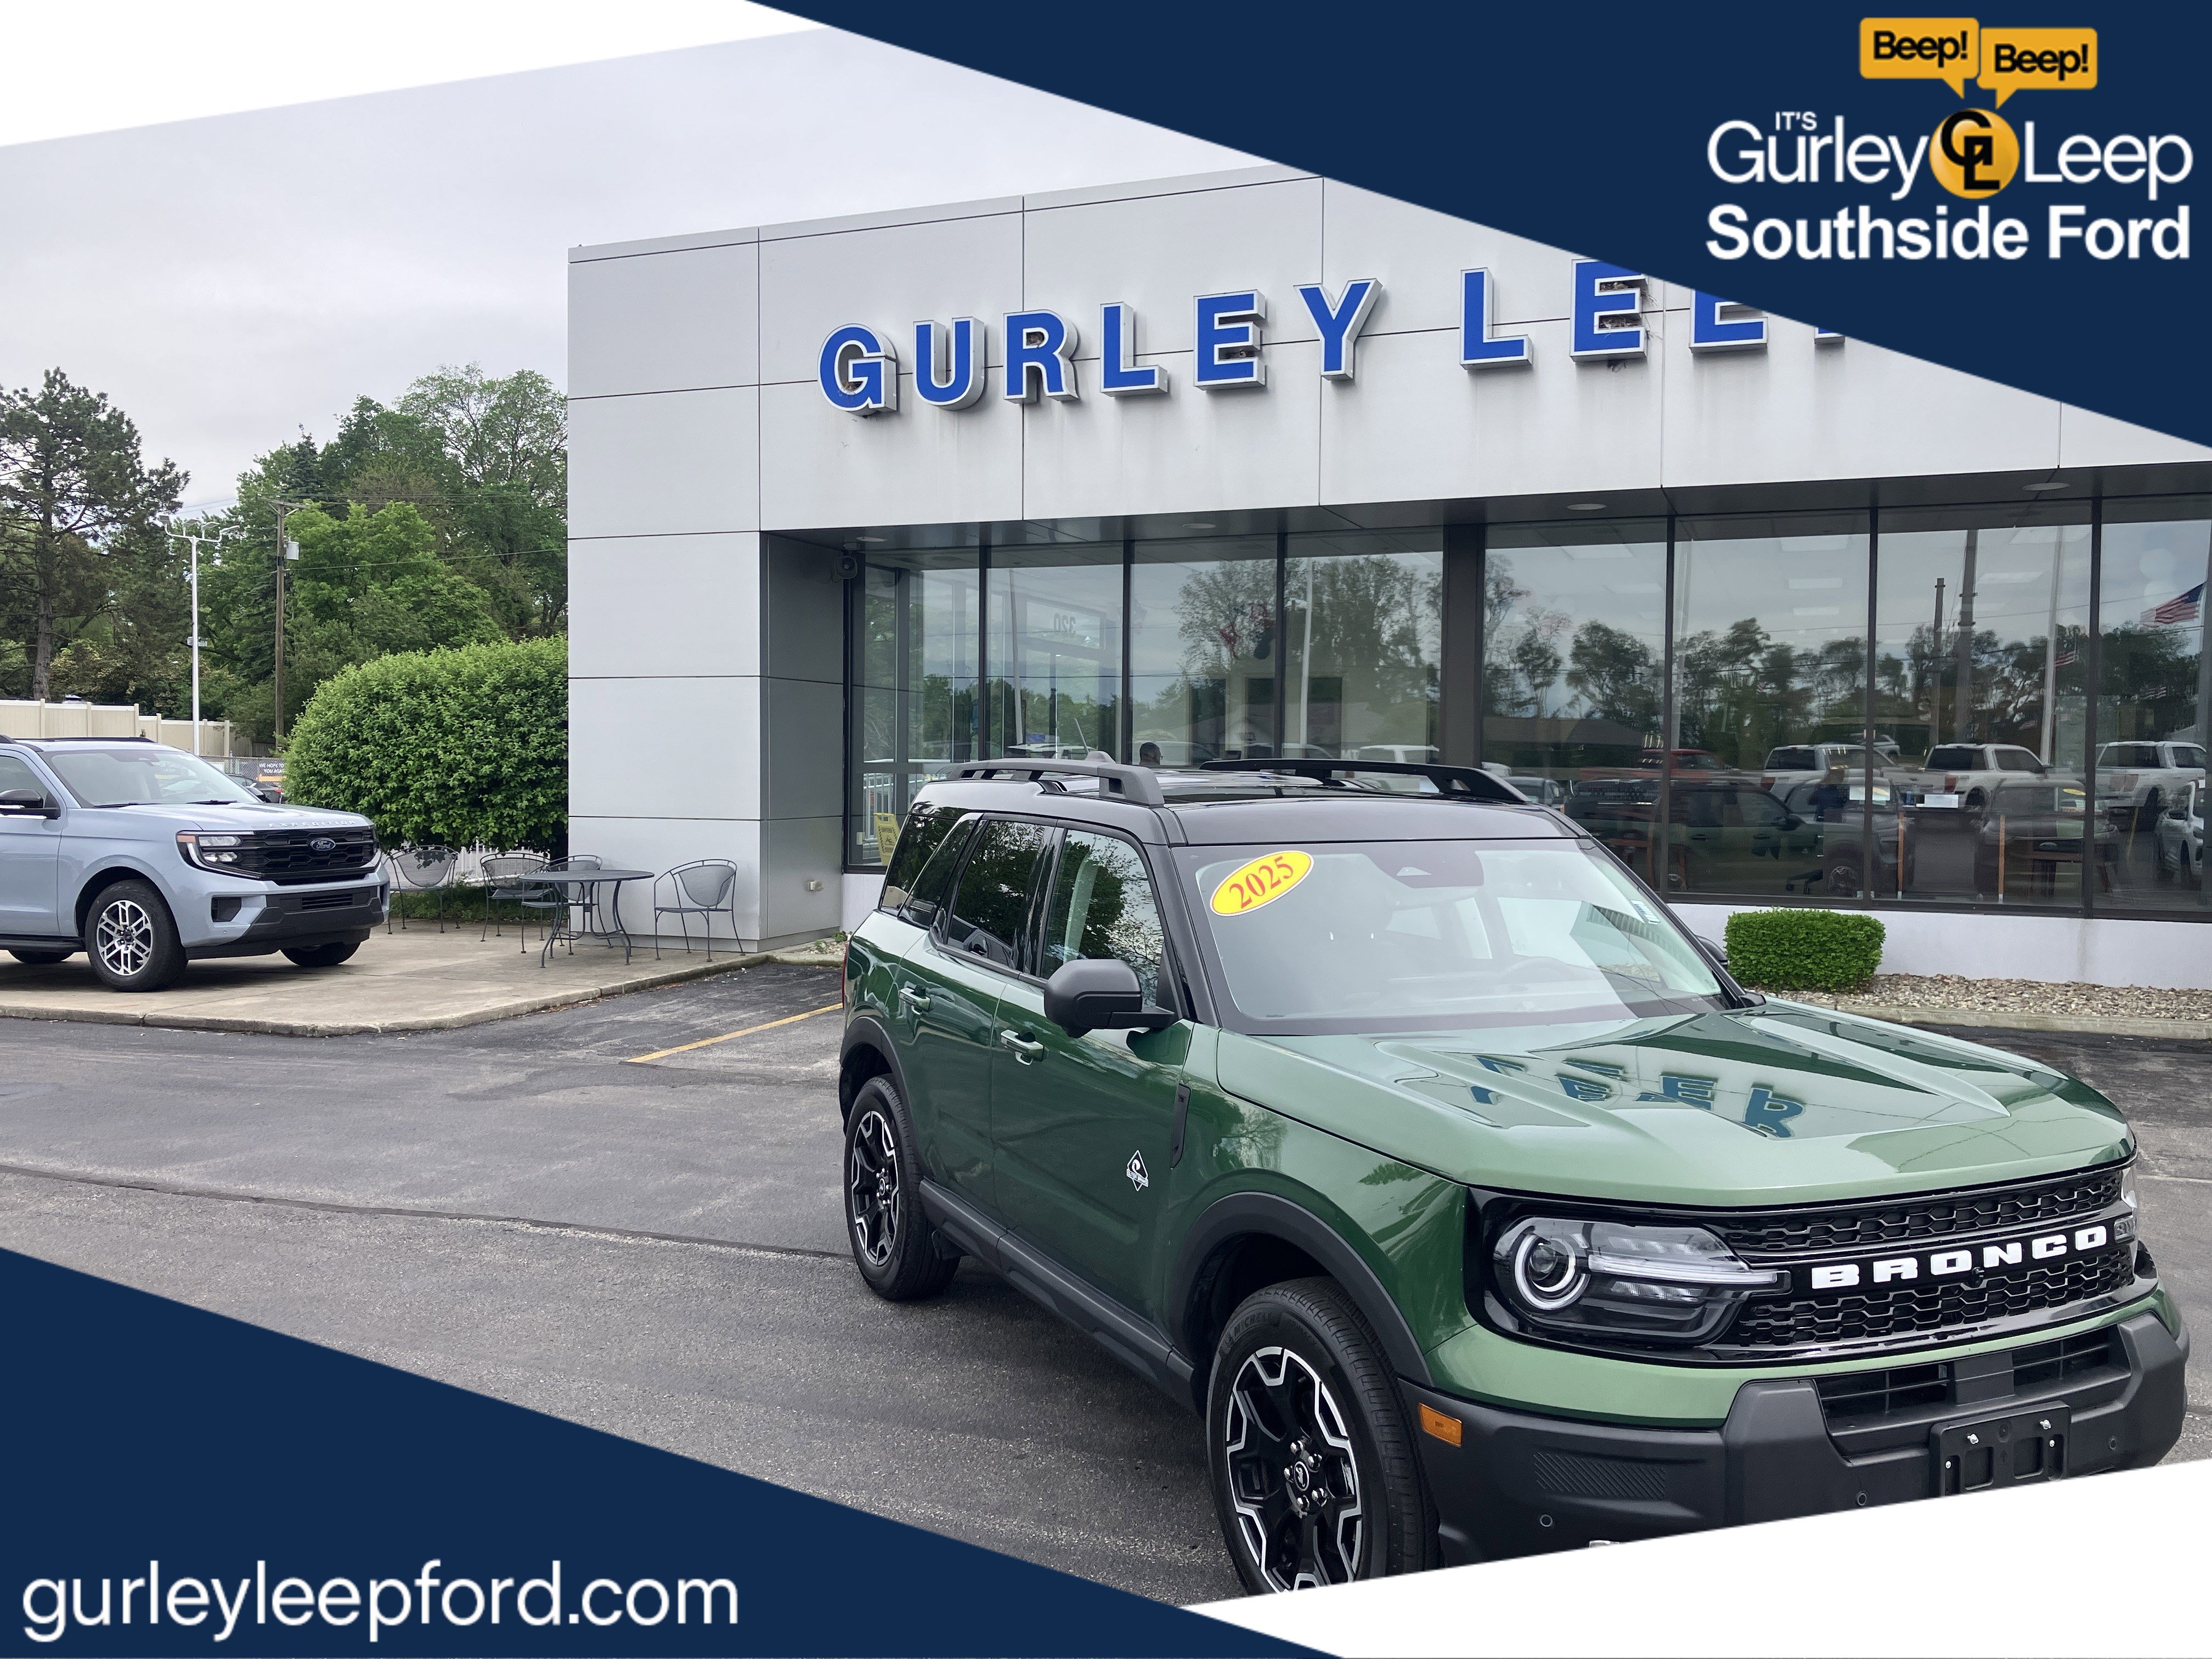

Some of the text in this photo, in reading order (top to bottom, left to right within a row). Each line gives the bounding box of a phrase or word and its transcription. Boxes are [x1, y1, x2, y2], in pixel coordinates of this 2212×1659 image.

[817, 258, 1845, 414] GURLEY LEE
[316, 840, 331, 849] Ford
[1228, 856, 1294, 909] 2025
[1812, 1226, 2107, 1290] BRONCO
